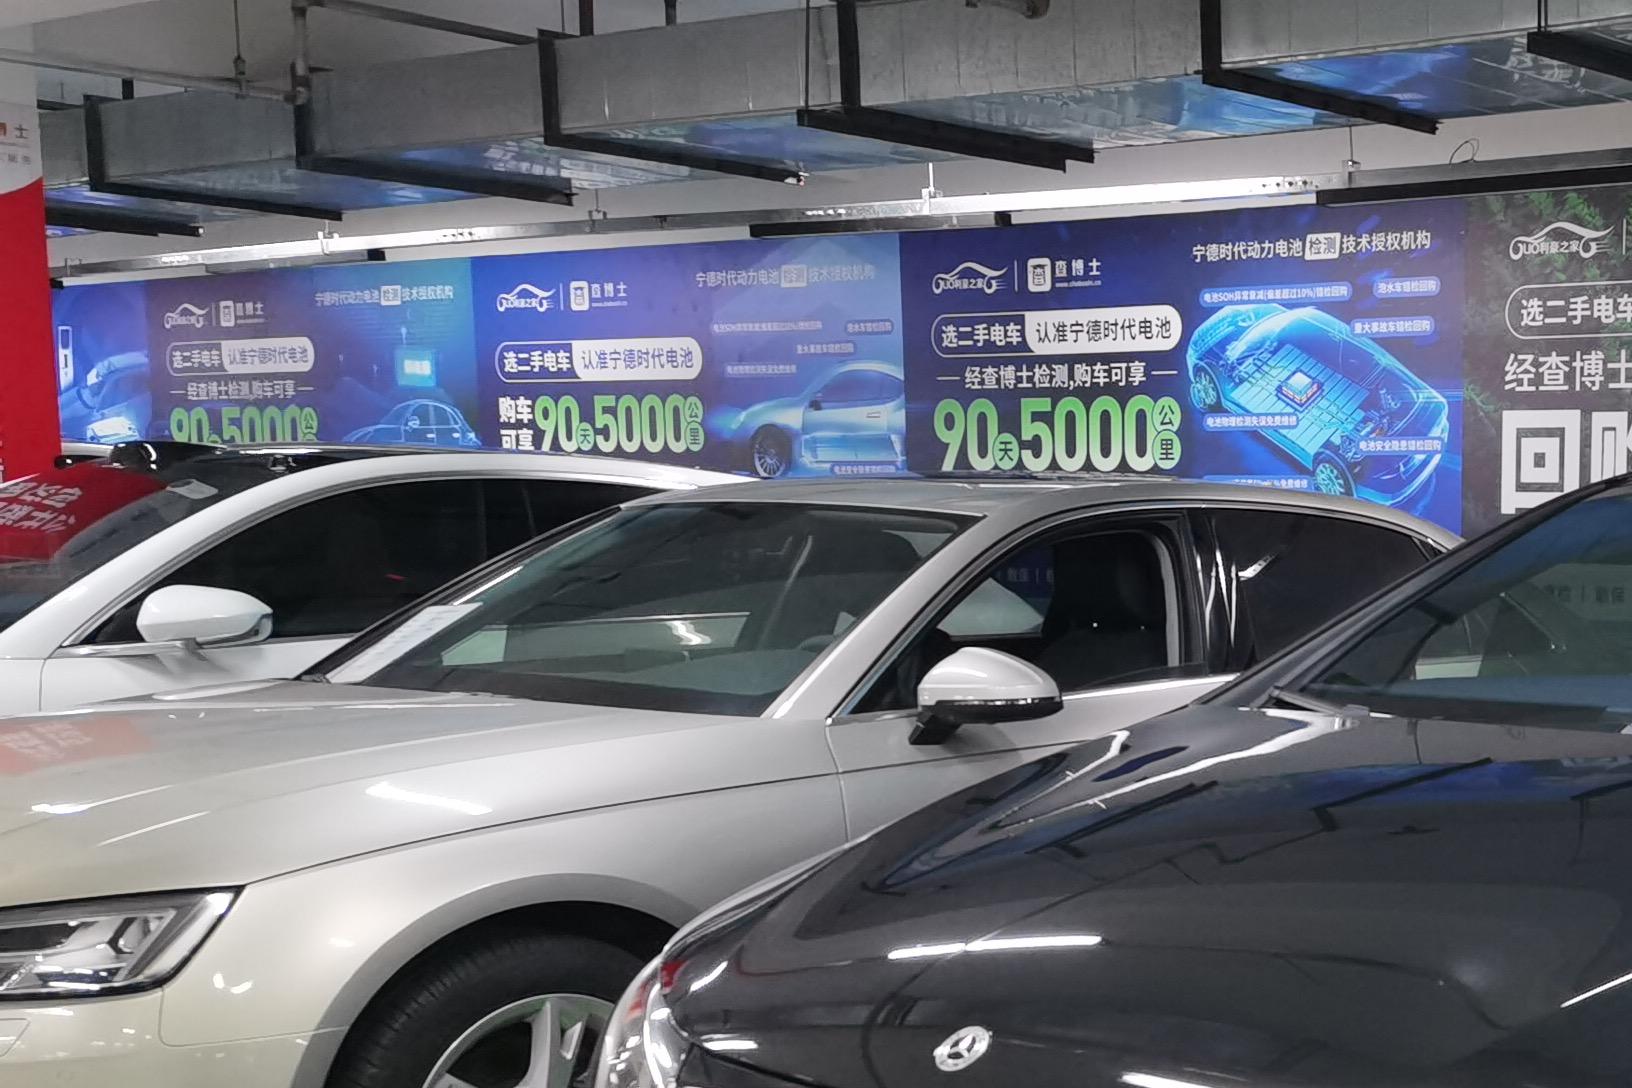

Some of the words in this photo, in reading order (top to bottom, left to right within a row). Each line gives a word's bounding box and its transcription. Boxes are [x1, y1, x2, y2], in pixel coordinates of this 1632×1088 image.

[941, 322, 1022, 348] 选二手电车
[1035, 316, 1172, 345] 认准宁德时代电池
[502, 350, 572, 374] 选二手电车
[580, 347, 694, 371] 认准宁德时代电池
